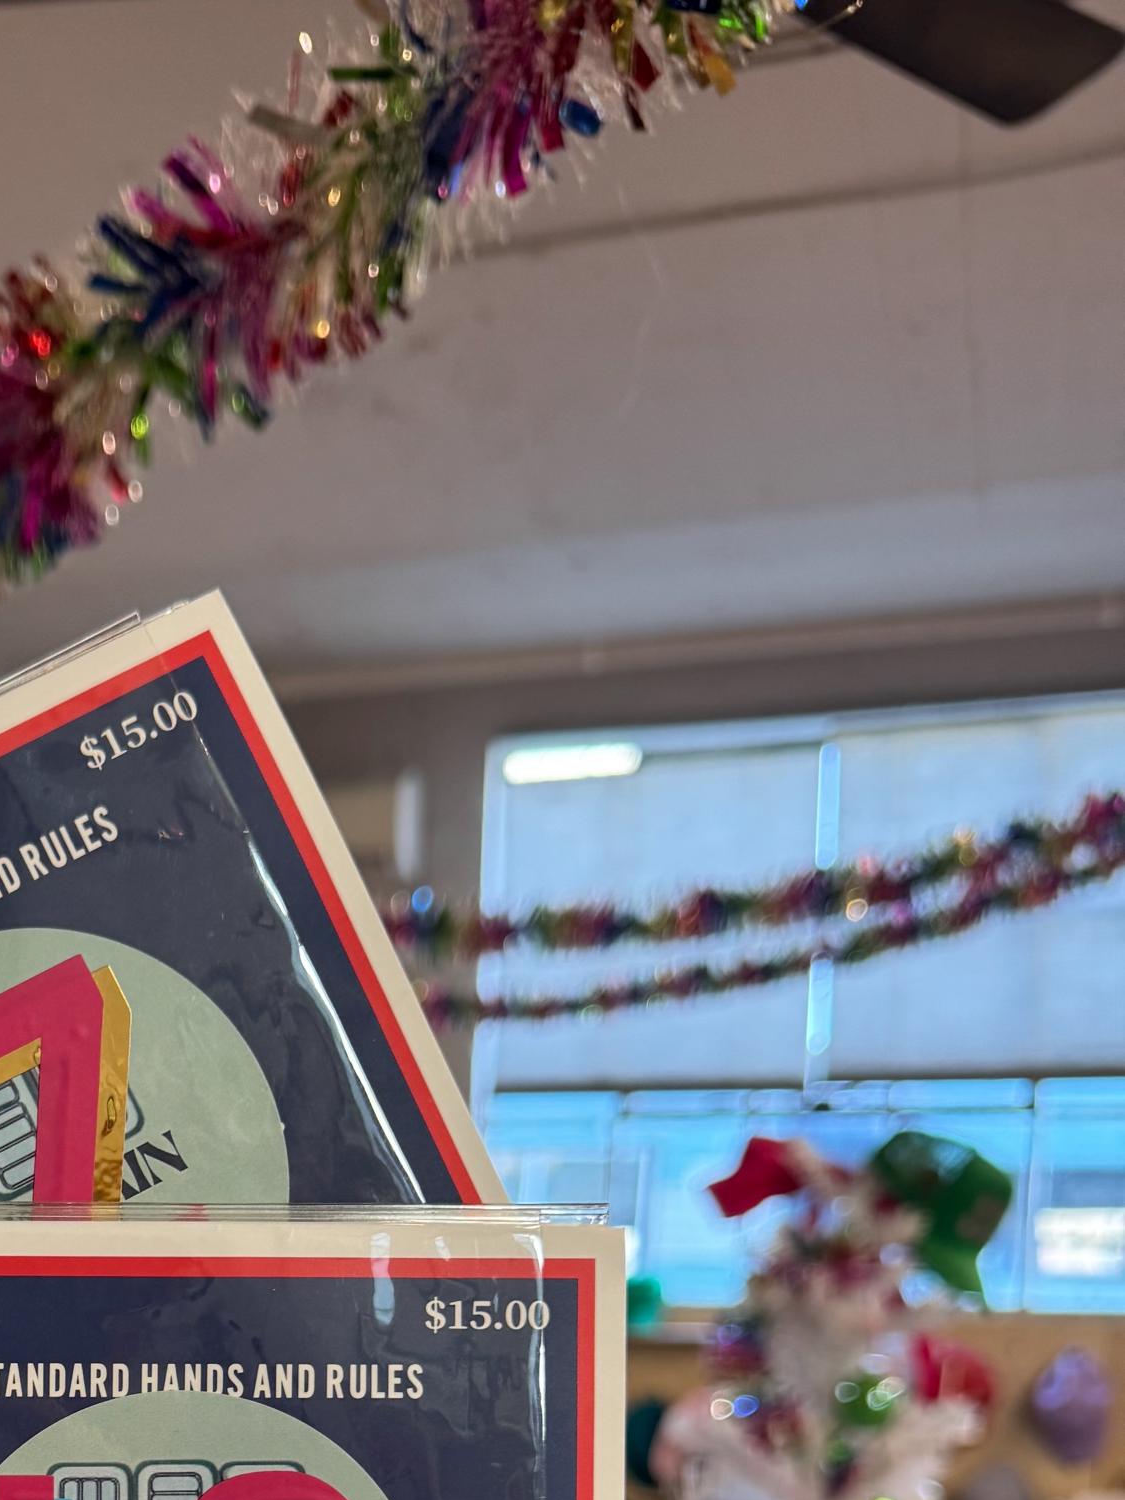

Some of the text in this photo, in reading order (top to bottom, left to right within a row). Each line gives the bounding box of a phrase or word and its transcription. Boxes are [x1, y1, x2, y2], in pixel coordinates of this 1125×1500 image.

[79, 692, 198, 770] $15.00
[18, 806, 119, 884] RULES
[424, 1298, 551, 1333] $15.00
[141, 1363, 244, 1397] HANDS
[253, 1364, 315, 1398] AND
[326, 1364, 424, 1399] RULES
